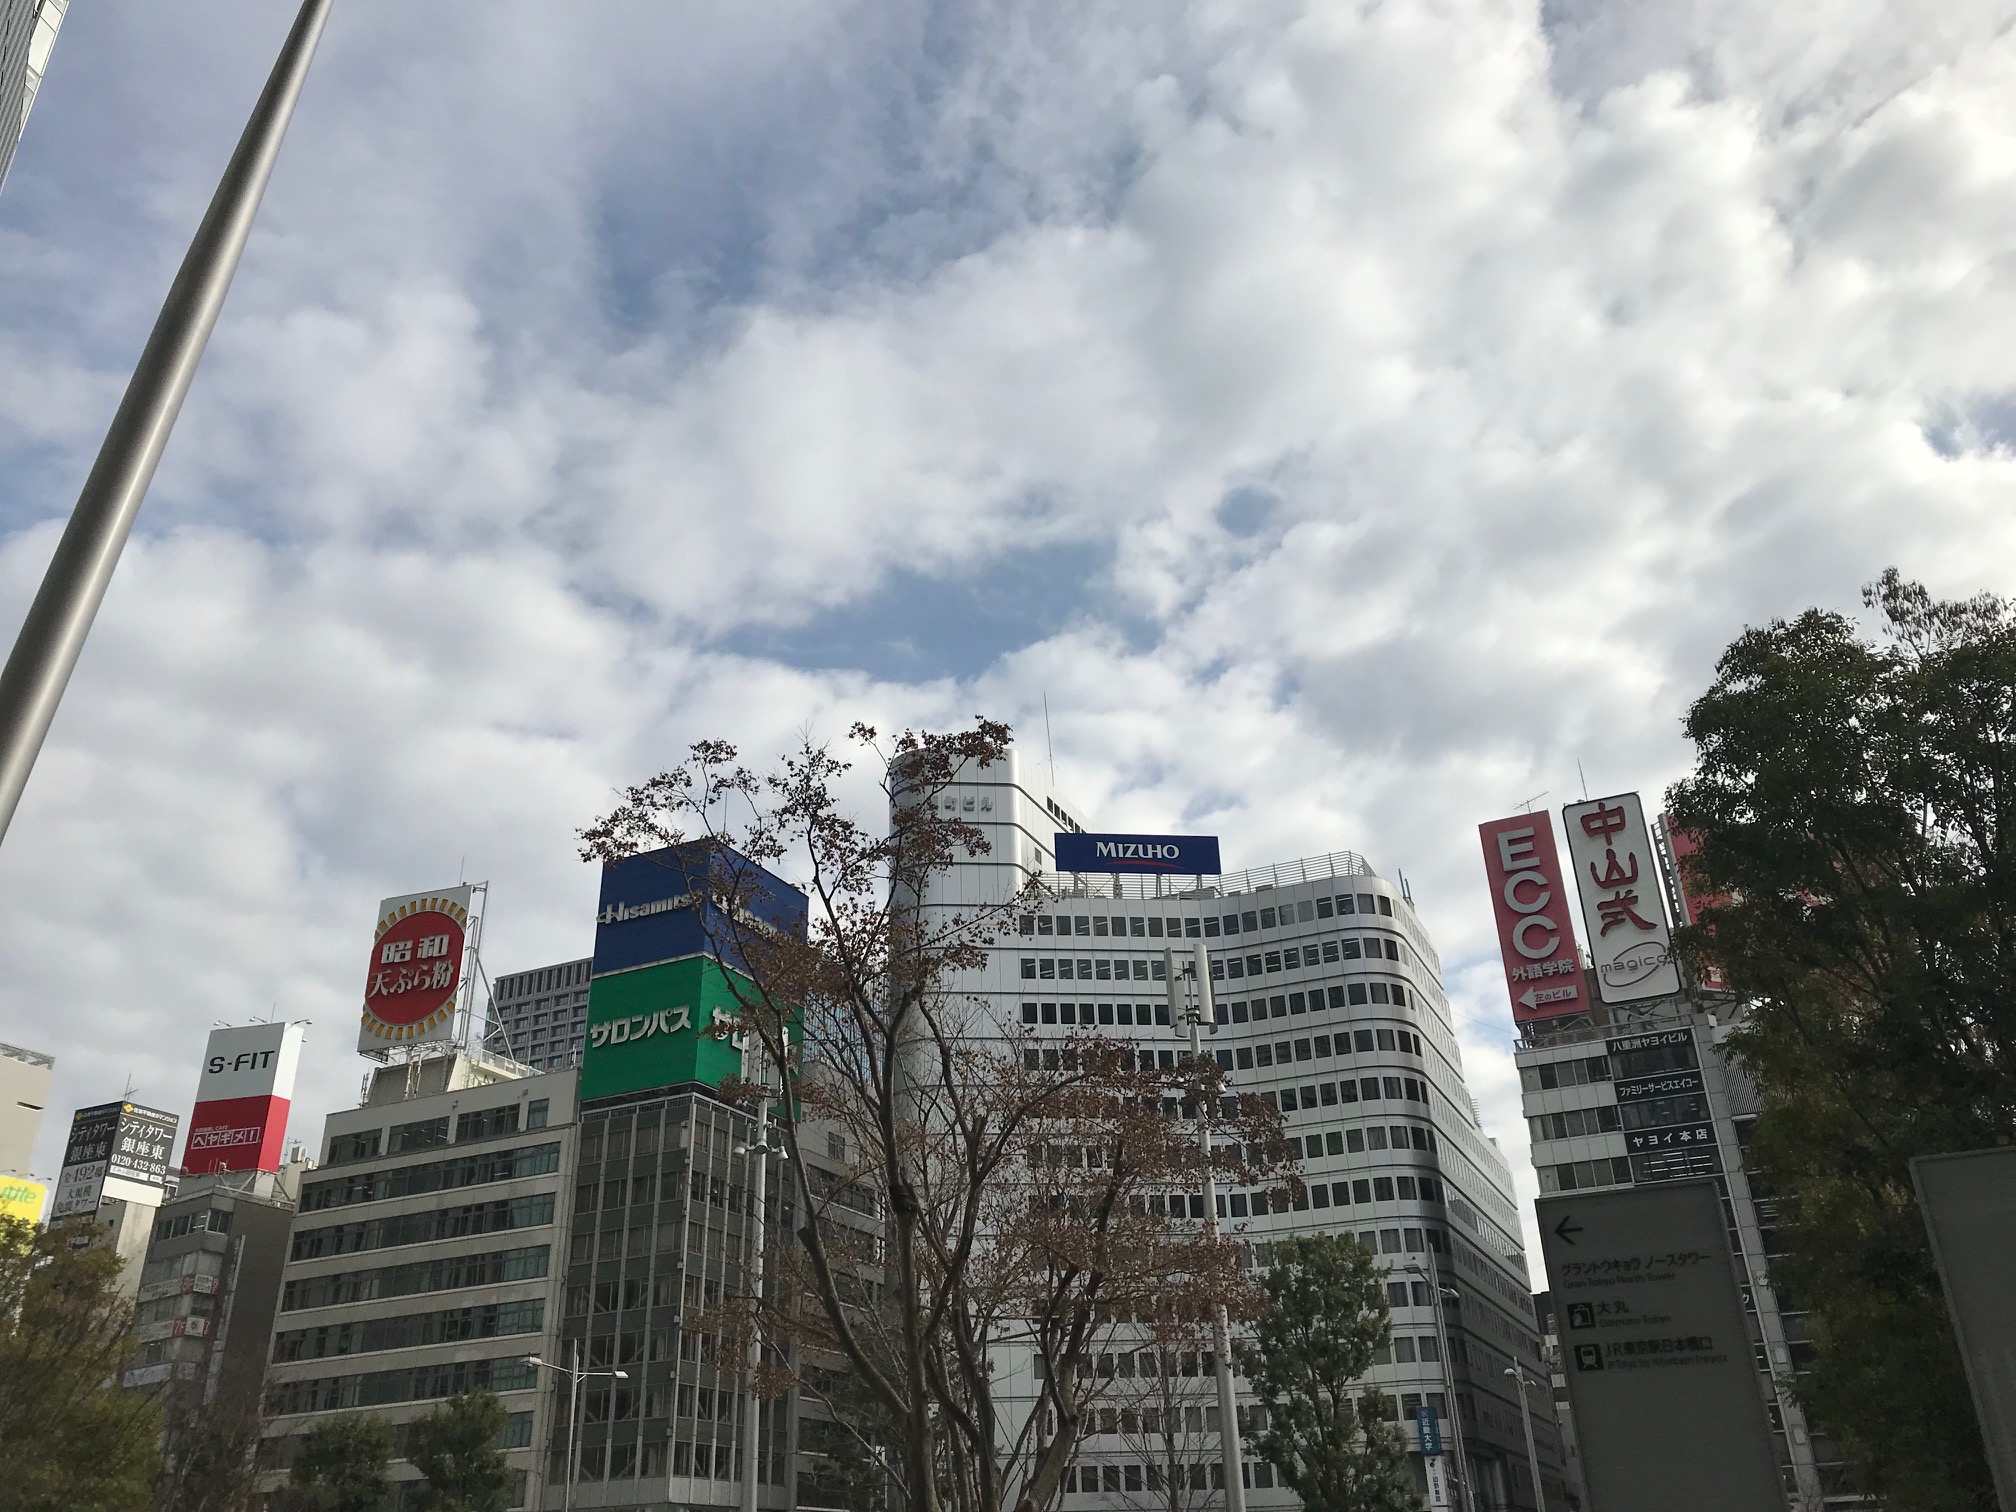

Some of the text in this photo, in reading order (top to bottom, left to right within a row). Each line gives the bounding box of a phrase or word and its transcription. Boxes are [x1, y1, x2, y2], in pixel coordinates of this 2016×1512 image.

[1096, 841, 1180, 859] MIZUHO
[1580, 802, 1658, 938] 中山式
[1497, 826, 1560, 960] ECC
[596, 891, 702, 924] Hisamits
[380, 933, 450, 964] 昭和
[366, 960, 454, 999] 天ぷら粉
[1512, 958, 1575, 982] 外語学院
[1533, 989, 1572, 1002] 左のビル
[590, 1005, 692, 1048] サロンパス
[1612, 1032, 1688, 1052] 八重洲ヤヨイビル
[208, 1050, 275, 1074] S-FIT
[1619, 1078, 1699, 1097] ファミリーサービスエイコー
[120, 1117, 173, 1142] シティタワー
[1633, 1128, 1708, 1147] ヤヨイ本店
[121, 1137, 165, 1160] 銀座東
[111, 1153, 166, 1175] 0120-432-863
[1645, 1252, 1712, 1269] ノースタワー
[1597, 1300, 1630, 1315] 大丸
